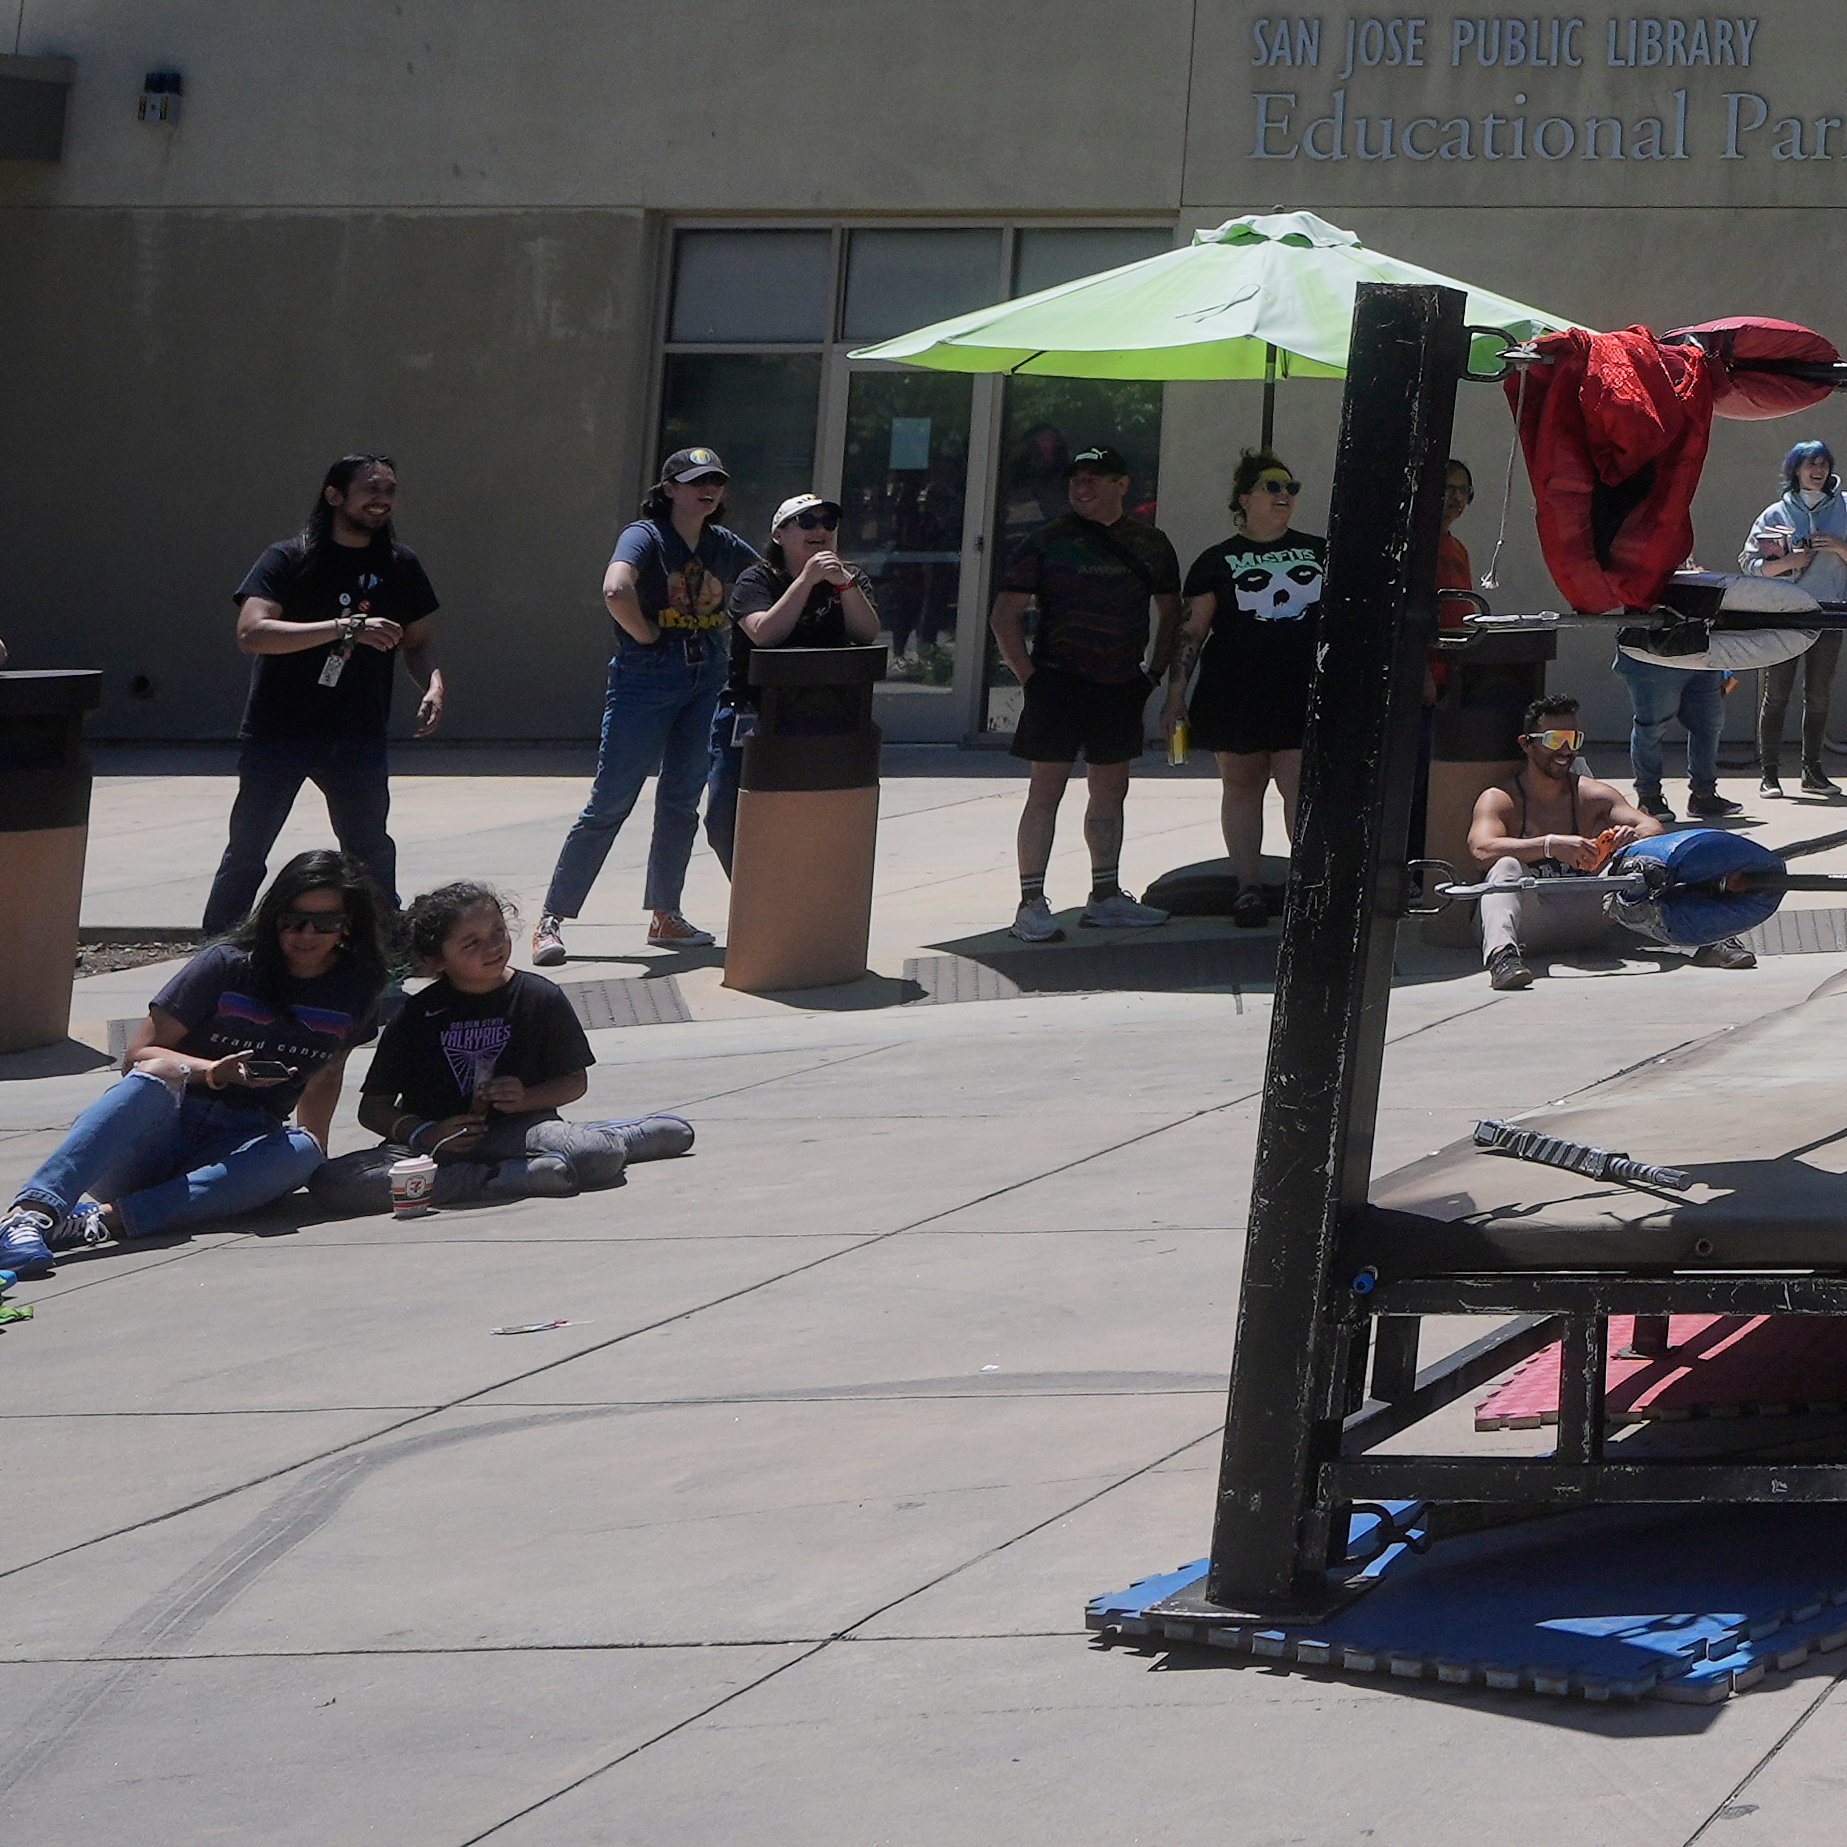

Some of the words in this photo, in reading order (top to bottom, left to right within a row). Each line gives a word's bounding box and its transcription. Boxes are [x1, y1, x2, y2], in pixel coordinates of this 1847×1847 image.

[1252, 18, 1320, 67] SAN
[1338, 18, 1426, 80] JOSE
[1452, 18, 1583, 67] PUBLIC
[1607, 18, 1758, 67] LIBRARY
[1248, 87, 1689, 161] Educational
[210, 1032, 266, 1049] grand
[440, 1024, 512, 1049] VALKYRIES
